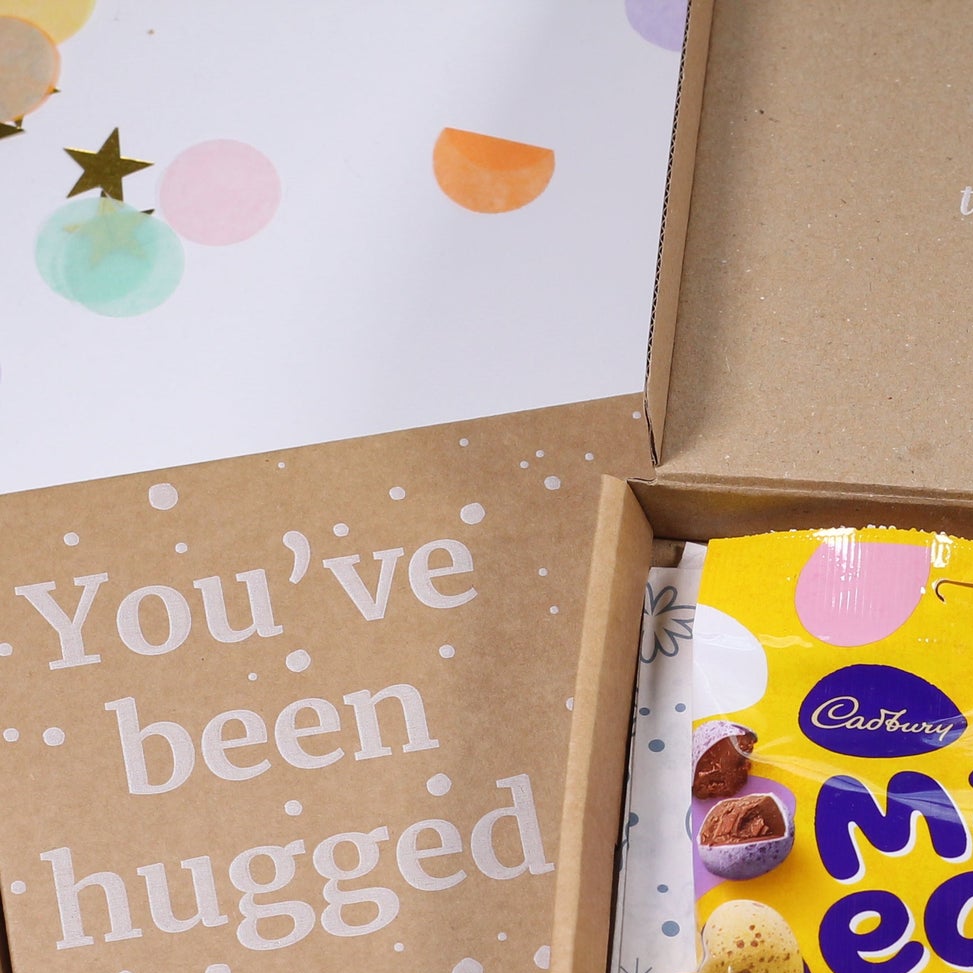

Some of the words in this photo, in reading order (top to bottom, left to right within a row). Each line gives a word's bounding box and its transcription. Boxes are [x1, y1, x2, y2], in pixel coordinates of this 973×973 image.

[14, 530, 479, 670] You’ve
[104, 683, 440, 795] been
[810, 695, 954, 742] Cadbury
[40, 773, 556, 950] hugged
